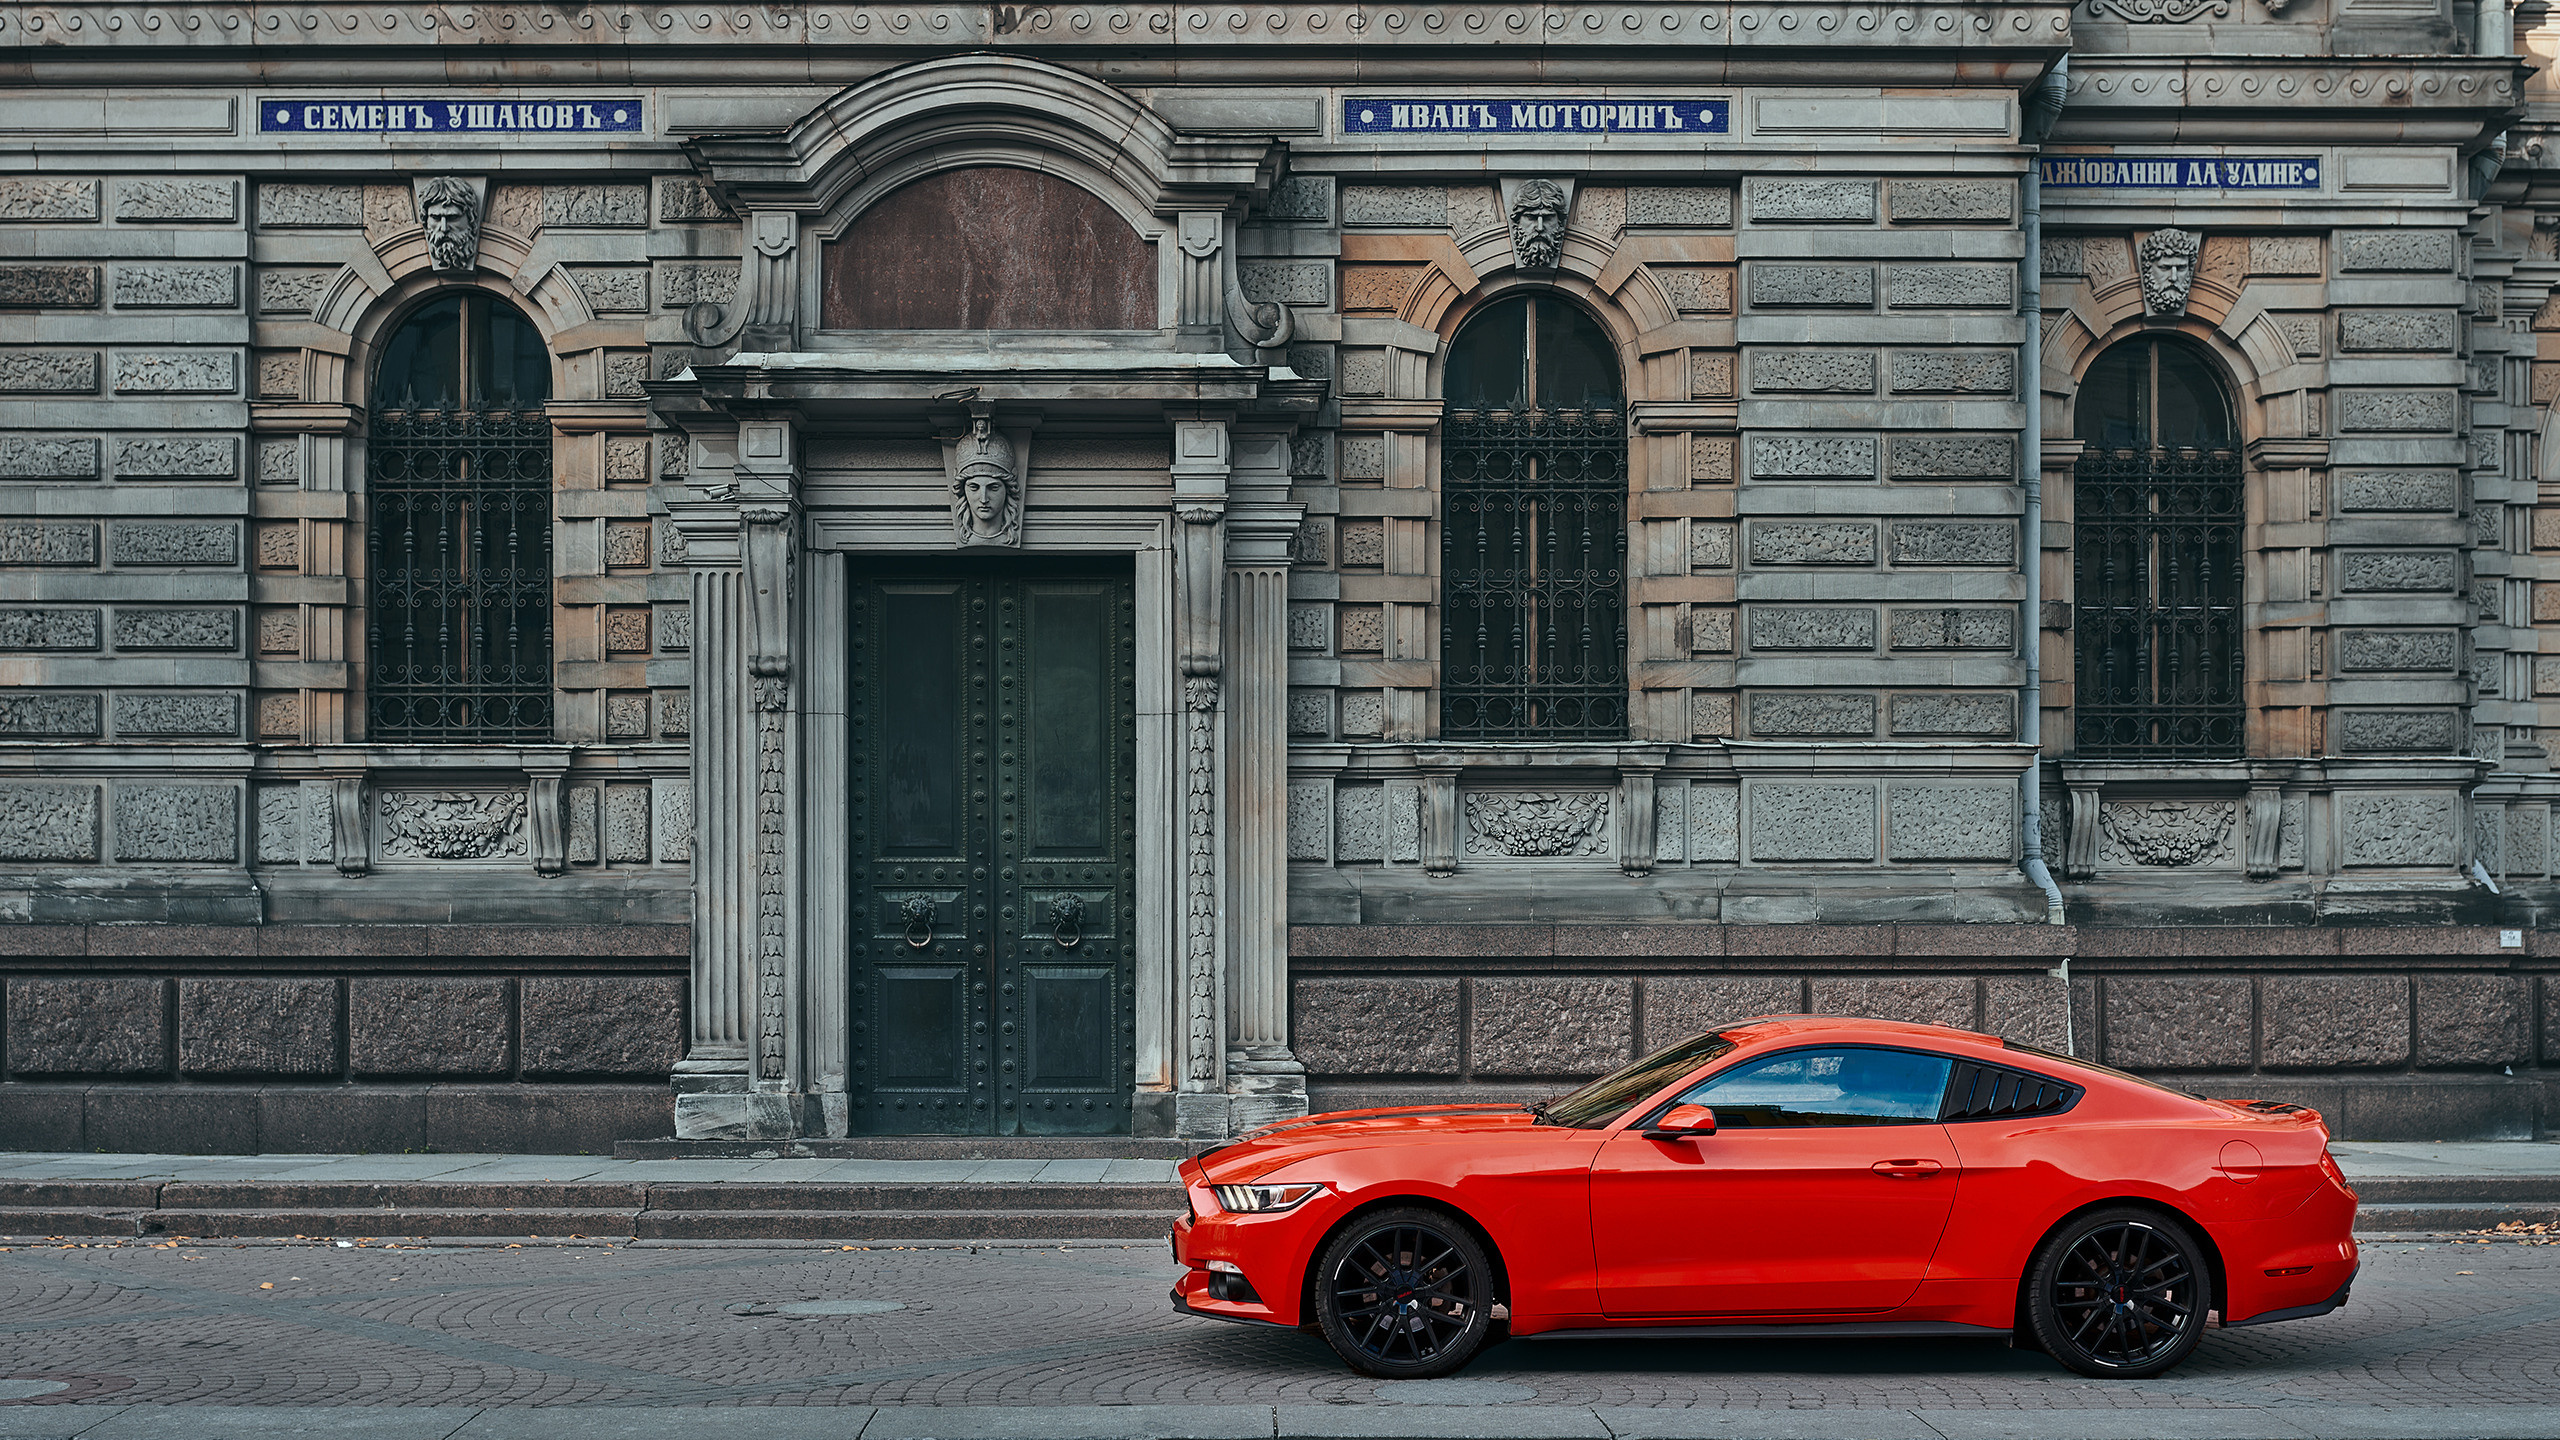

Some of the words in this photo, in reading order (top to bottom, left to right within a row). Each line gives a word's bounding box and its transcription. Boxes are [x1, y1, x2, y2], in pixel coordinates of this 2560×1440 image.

[304, 105, 433, 129] СЕМЕНЪ
[446, 105, 601, 129] УШАКОВЪ
[1391, 105, 1498, 129] ИВАНЪ
[1511, 105, 1683, 129] МОТОРИНЪ
[2186, 162, 2218, 186] ДА
[2225, 163, 2303, 187] УДИНЕ
